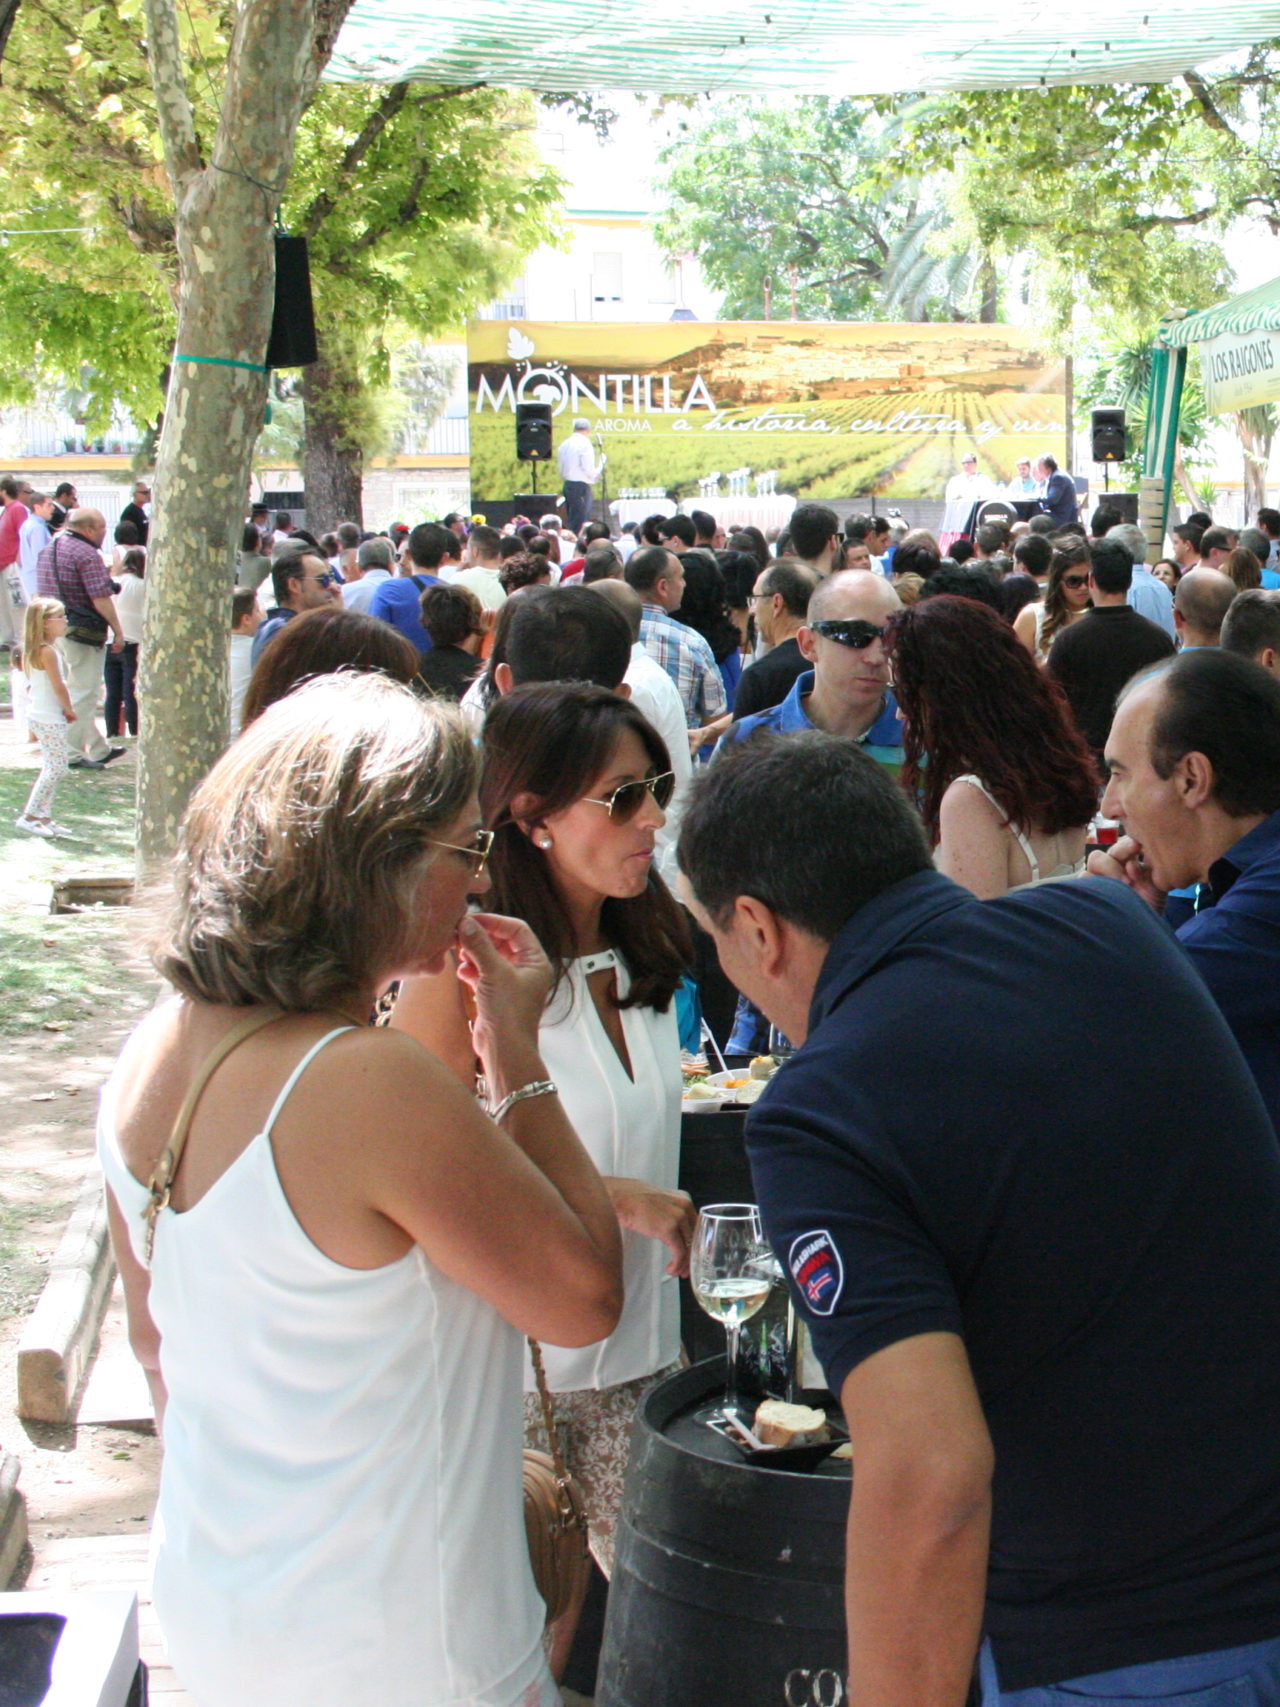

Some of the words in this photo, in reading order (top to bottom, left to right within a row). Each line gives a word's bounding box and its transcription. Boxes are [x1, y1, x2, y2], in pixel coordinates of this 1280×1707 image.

[1211, 351, 1229, 383] LOS
[1228, 338, 1274, 379] RAIGONES
[475, 367, 718, 417] MONTILLA
[594, 418, 653, 432] AROMA
[702, 406, 841, 436] historia,
[851, 407, 967, 432] cultura
[975, 420, 1003, 445] y
